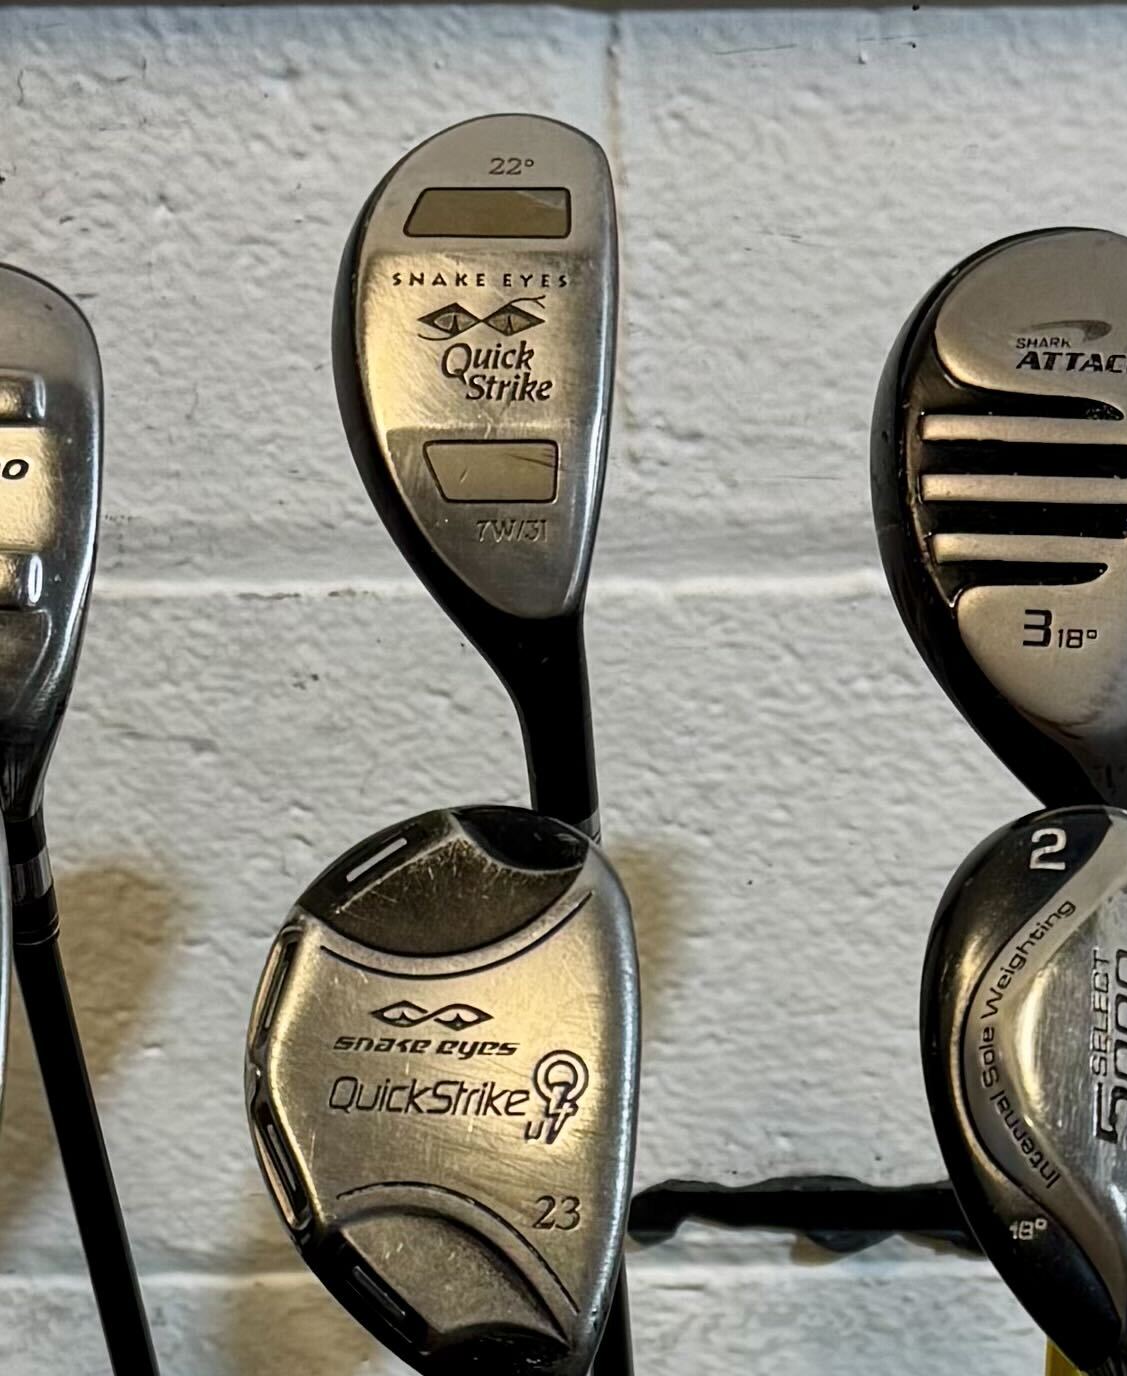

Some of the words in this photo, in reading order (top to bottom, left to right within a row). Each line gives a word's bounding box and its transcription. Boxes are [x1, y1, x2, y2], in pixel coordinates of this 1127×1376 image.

[489, 158, 535, 176] 22°
[392, 272, 486, 287] SNAKE
[503, 272, 568, 288] EYES
[441, 340, 535, 384] Quick
[1015, 337, 1071, 350] SHARK
[465, 373, 553, 402] Strike
[1022, 609, 1052, 648] 3
[1029, 827, 1067, 871] 2
[981, 899, 1076, 1018] Weighting
[1090, 947, 1111, 1077] SELECT
[333, 1035, 432, 1054] snake
[440, 1040, 520, 1060] eyes
[978, 1023, 1000, 1090] Sole
[327, 1075, 530, 1118] QuickStrike
[993, 1088, 1061, 1189] Internal
[532, 1194, 582, 1231] 23
